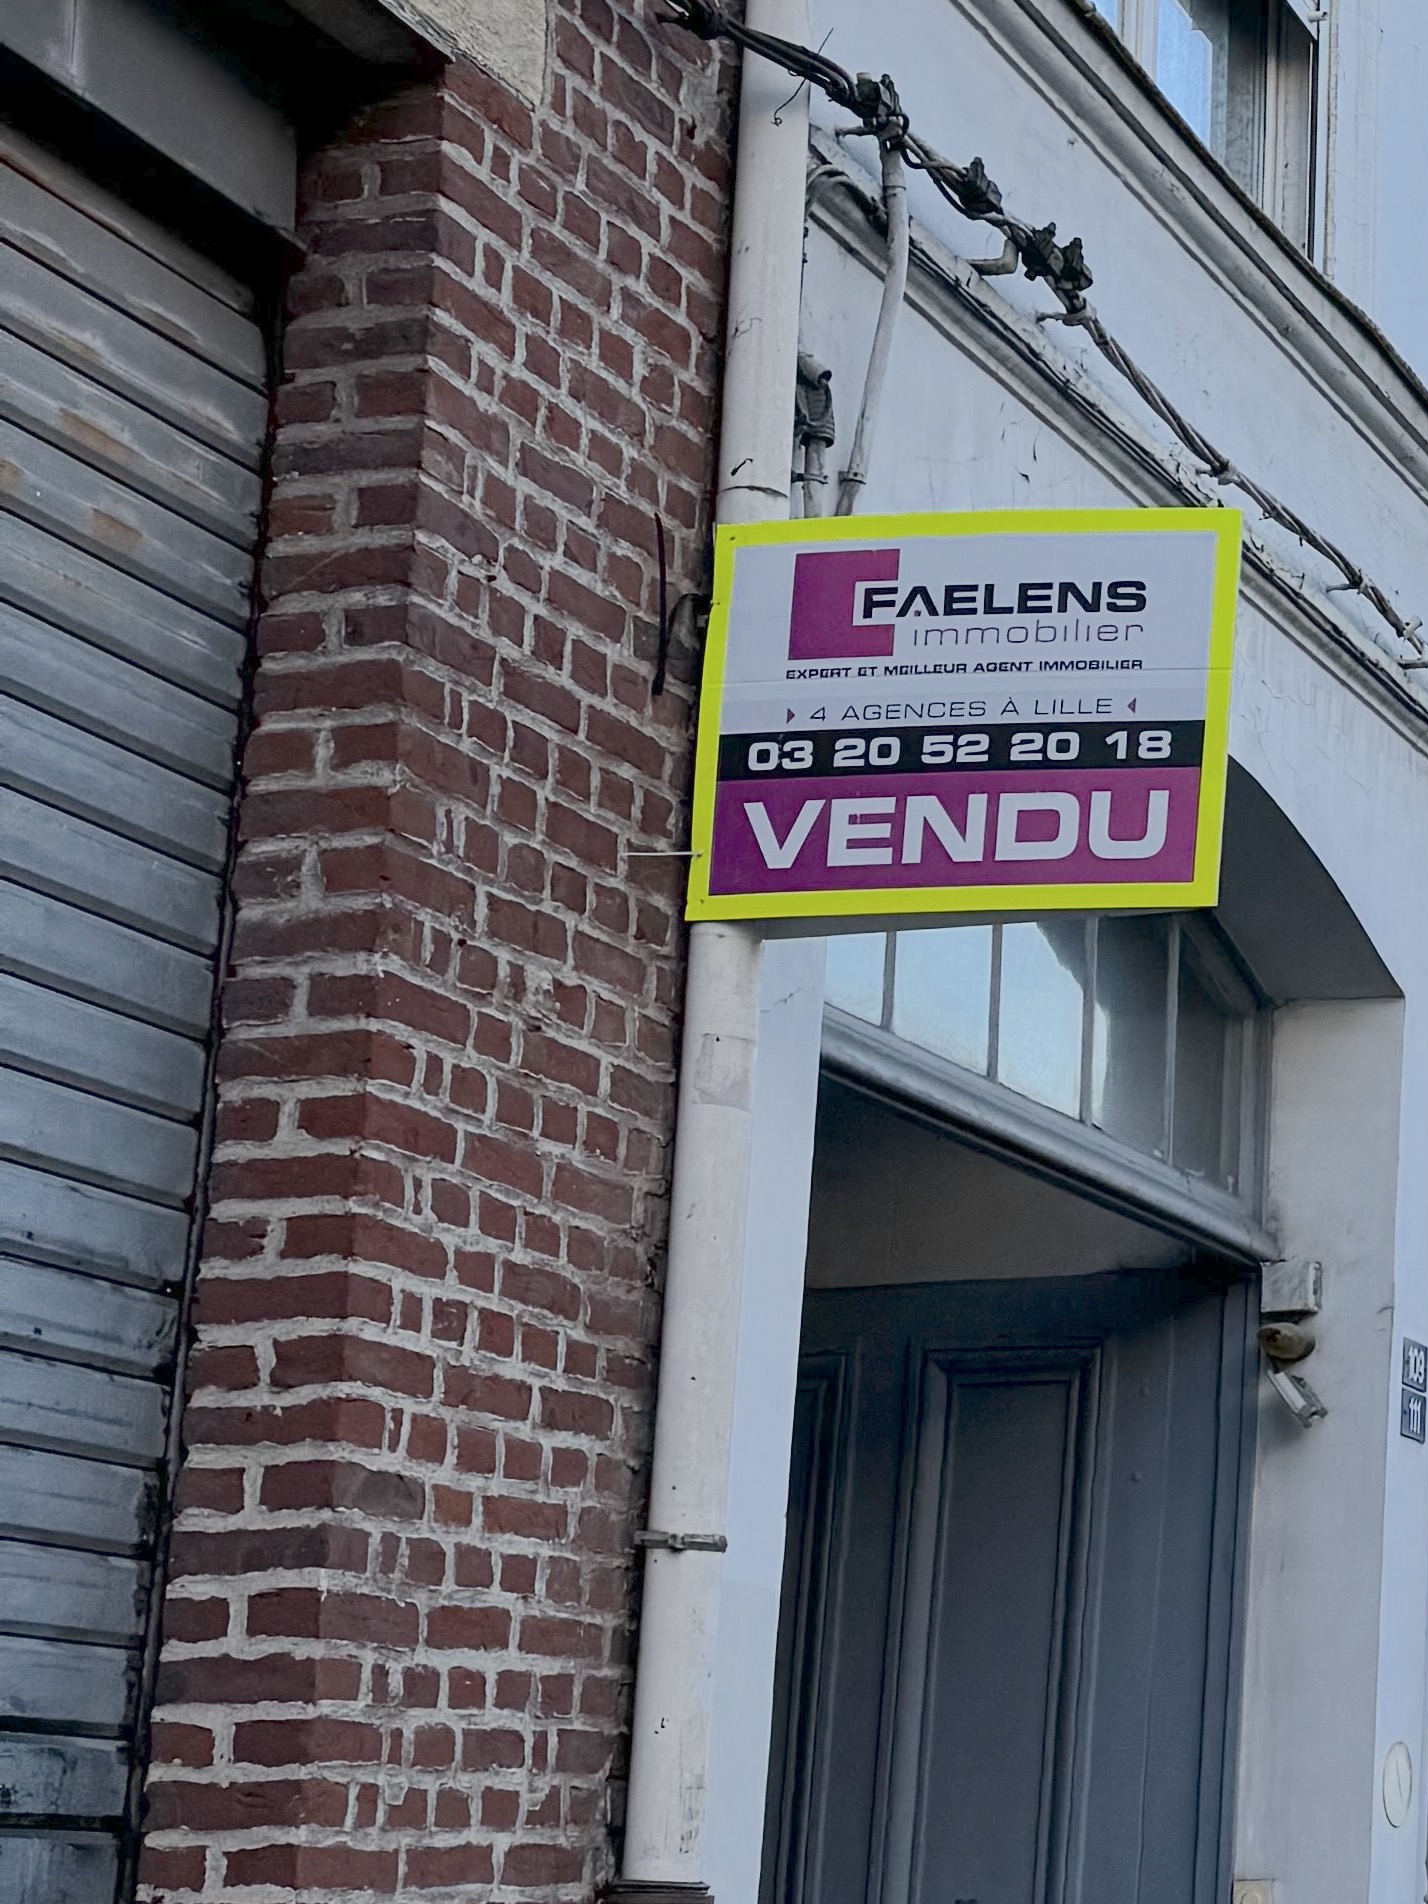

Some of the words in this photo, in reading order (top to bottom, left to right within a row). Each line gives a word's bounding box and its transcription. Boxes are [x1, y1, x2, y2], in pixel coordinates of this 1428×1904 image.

[863, 581, 1146, 619] FAELENS
[914, 618, 1144, 647] immobilier
[786, 667, 852, 679] EXPERT
[857, 666, 878, 677] ET
[884, 663, 967, 676] MEILLEUR
[973, 661, 1033, 673] AGENT
[1039, 659, 1143, 672] IMMOBILIER
[810, 706, 826, 721] 4
[841, 701, 986, 721] AGENCES
[1000, 697, 1019, 716] À
[1034, 698, 1112, 715] LILLE
[748, 740, 813, 771] 03
[833, 736, 900, 767] 20
[921, 733, 990, 764] 52
[1010, 731, 1080, 761] 20
[1105, 730, 1172, 760] 18
[743, 789, 1170, 870] VENDU
[1409, 1397, 1421, 1434] 111
